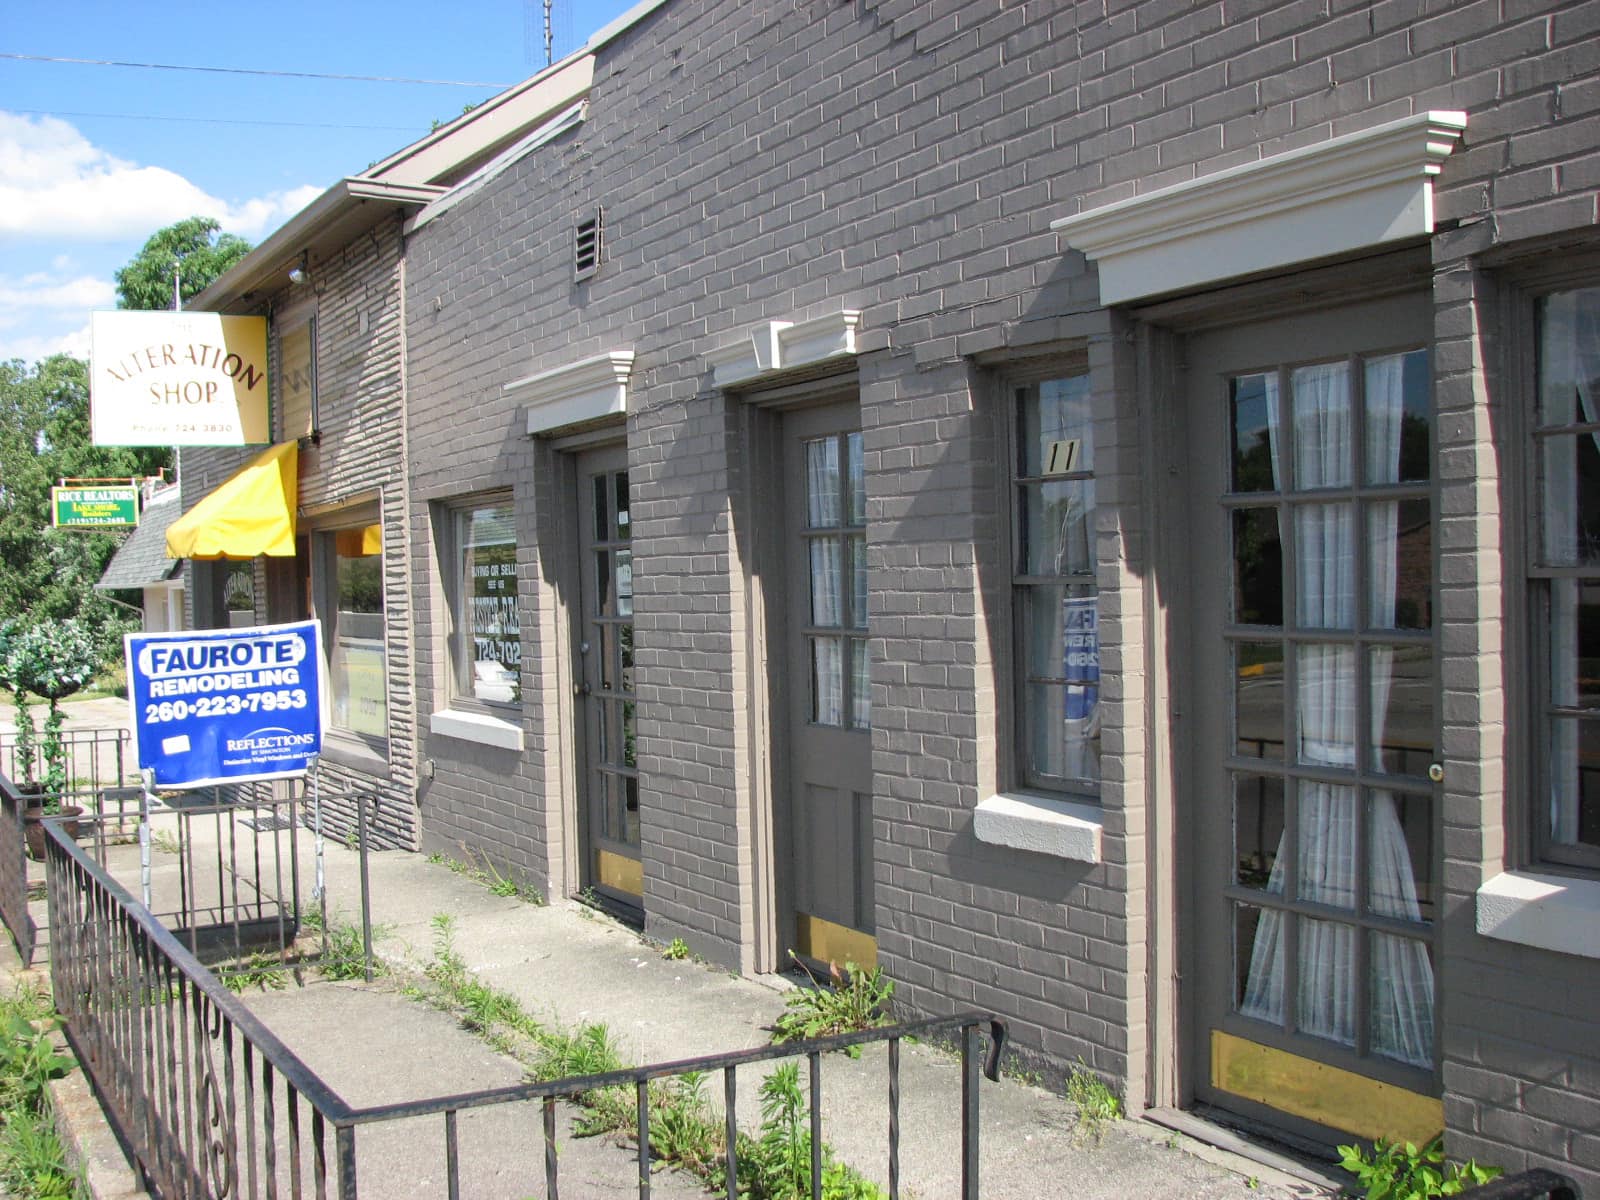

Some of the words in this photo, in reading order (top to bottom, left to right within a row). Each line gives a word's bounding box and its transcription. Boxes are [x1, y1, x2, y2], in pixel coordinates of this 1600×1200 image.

[150, 381, 218, 404] SHOP
[1049, 441, 1074, 472] 11
[58, 491, 82, 501] RICE
[84, 490, 134, 501] REALTORS
[490, 564, 500, 577] OR
[150, 639, 294, 675] FAUROTE
[150, 668, 299, 698] REMODELING
[226, 733, 315, 752] REFLECTIONS
